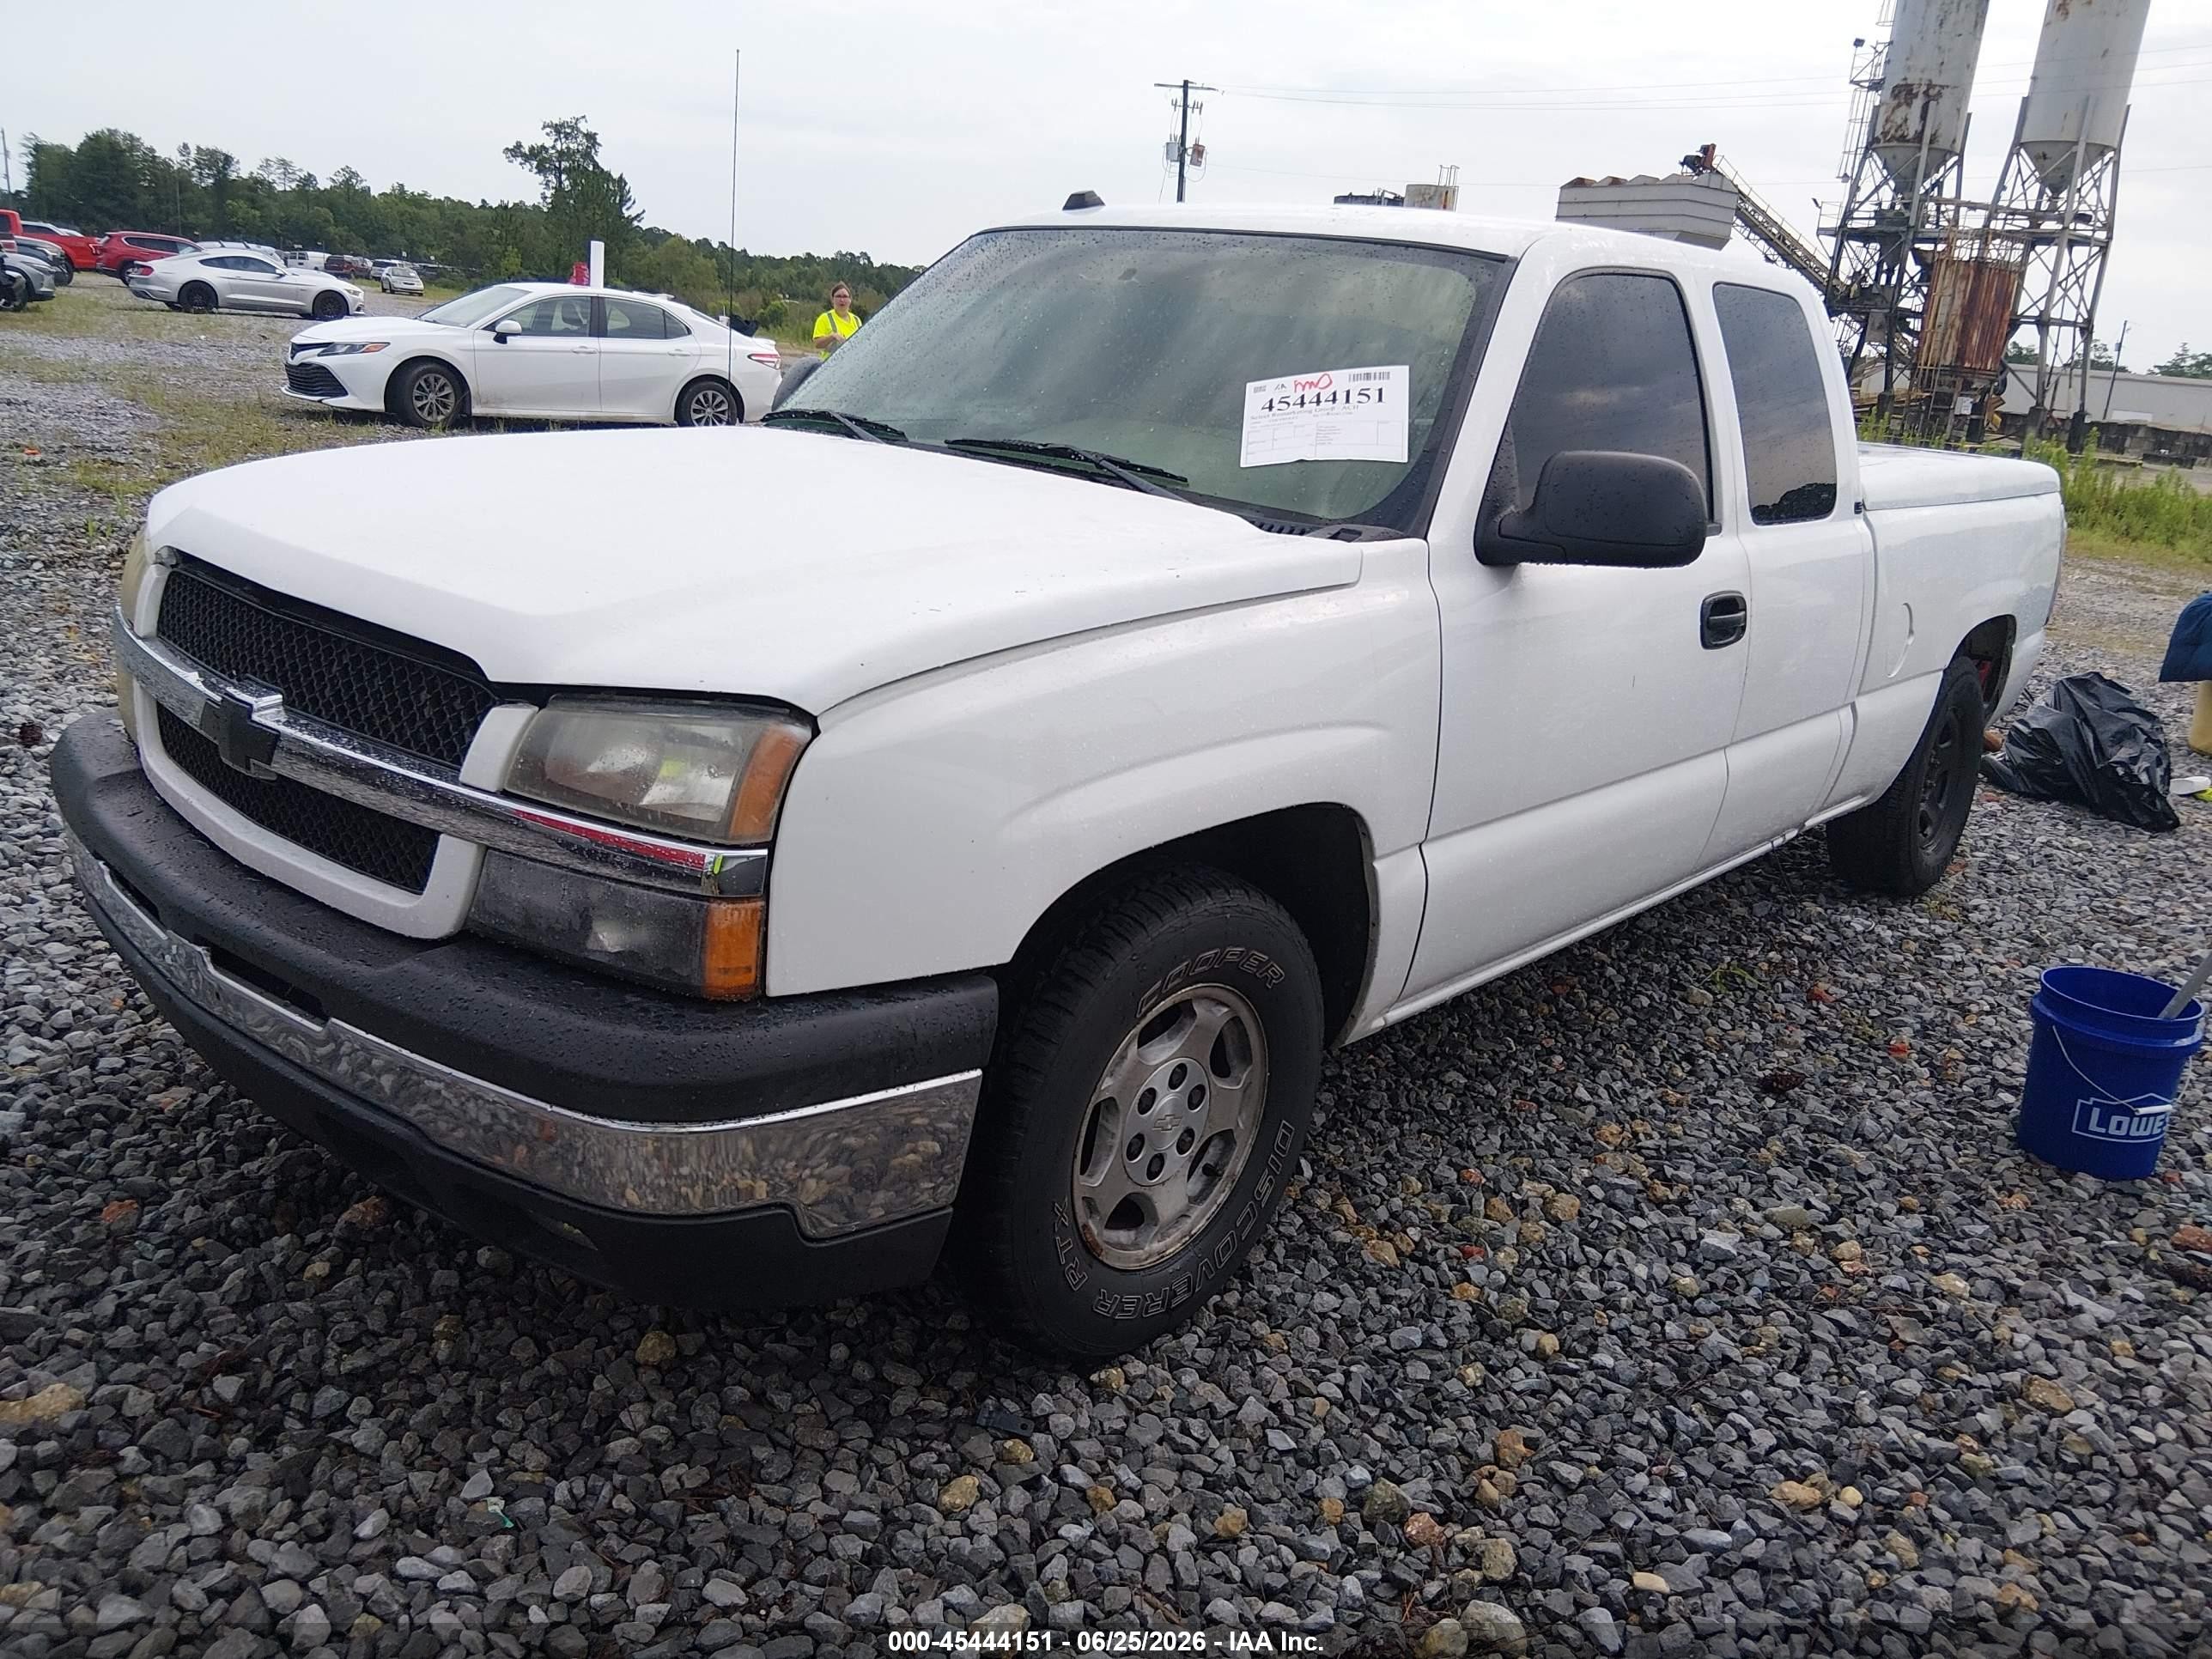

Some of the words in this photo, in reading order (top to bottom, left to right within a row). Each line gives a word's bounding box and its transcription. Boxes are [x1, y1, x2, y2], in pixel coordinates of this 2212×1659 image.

[1261, 386, 1387, 412] 45444151
[1136, 946, 1285, 1018] COOPER
[2087, 1107, 2169, 1136] LOWE
[1092, 1119, 1296, 1320] DISCOVERER
